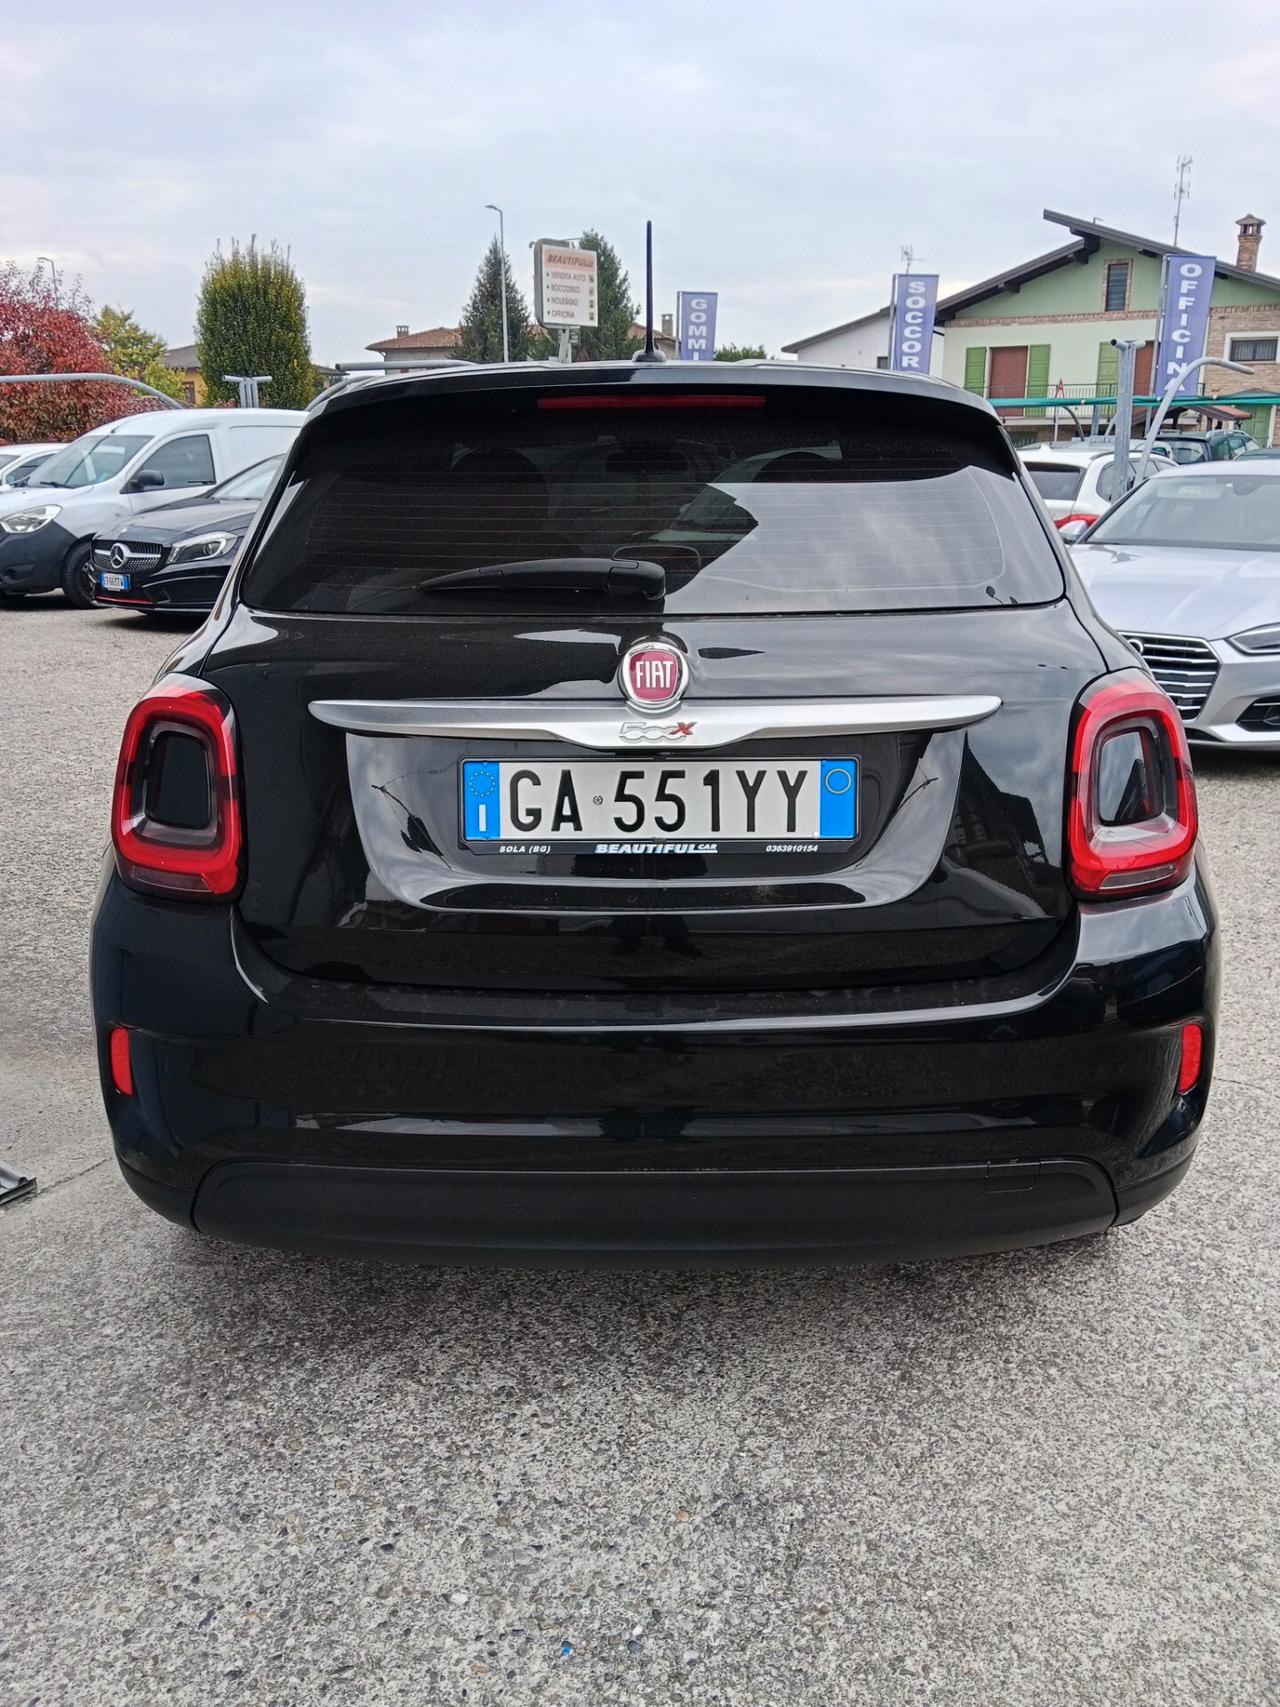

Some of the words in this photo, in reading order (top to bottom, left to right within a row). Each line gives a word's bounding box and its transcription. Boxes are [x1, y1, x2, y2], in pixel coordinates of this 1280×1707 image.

[547, 254, 587, 267] BEAUTIFUL
[687, 298, 708, 361] GOMMI
[635, 661, 674, 689] FIAT
[499, 845, 525, 853] SOLA
[528, 845, 551, 855] (BG)
[765, 844, 819, 852] 0363910154
